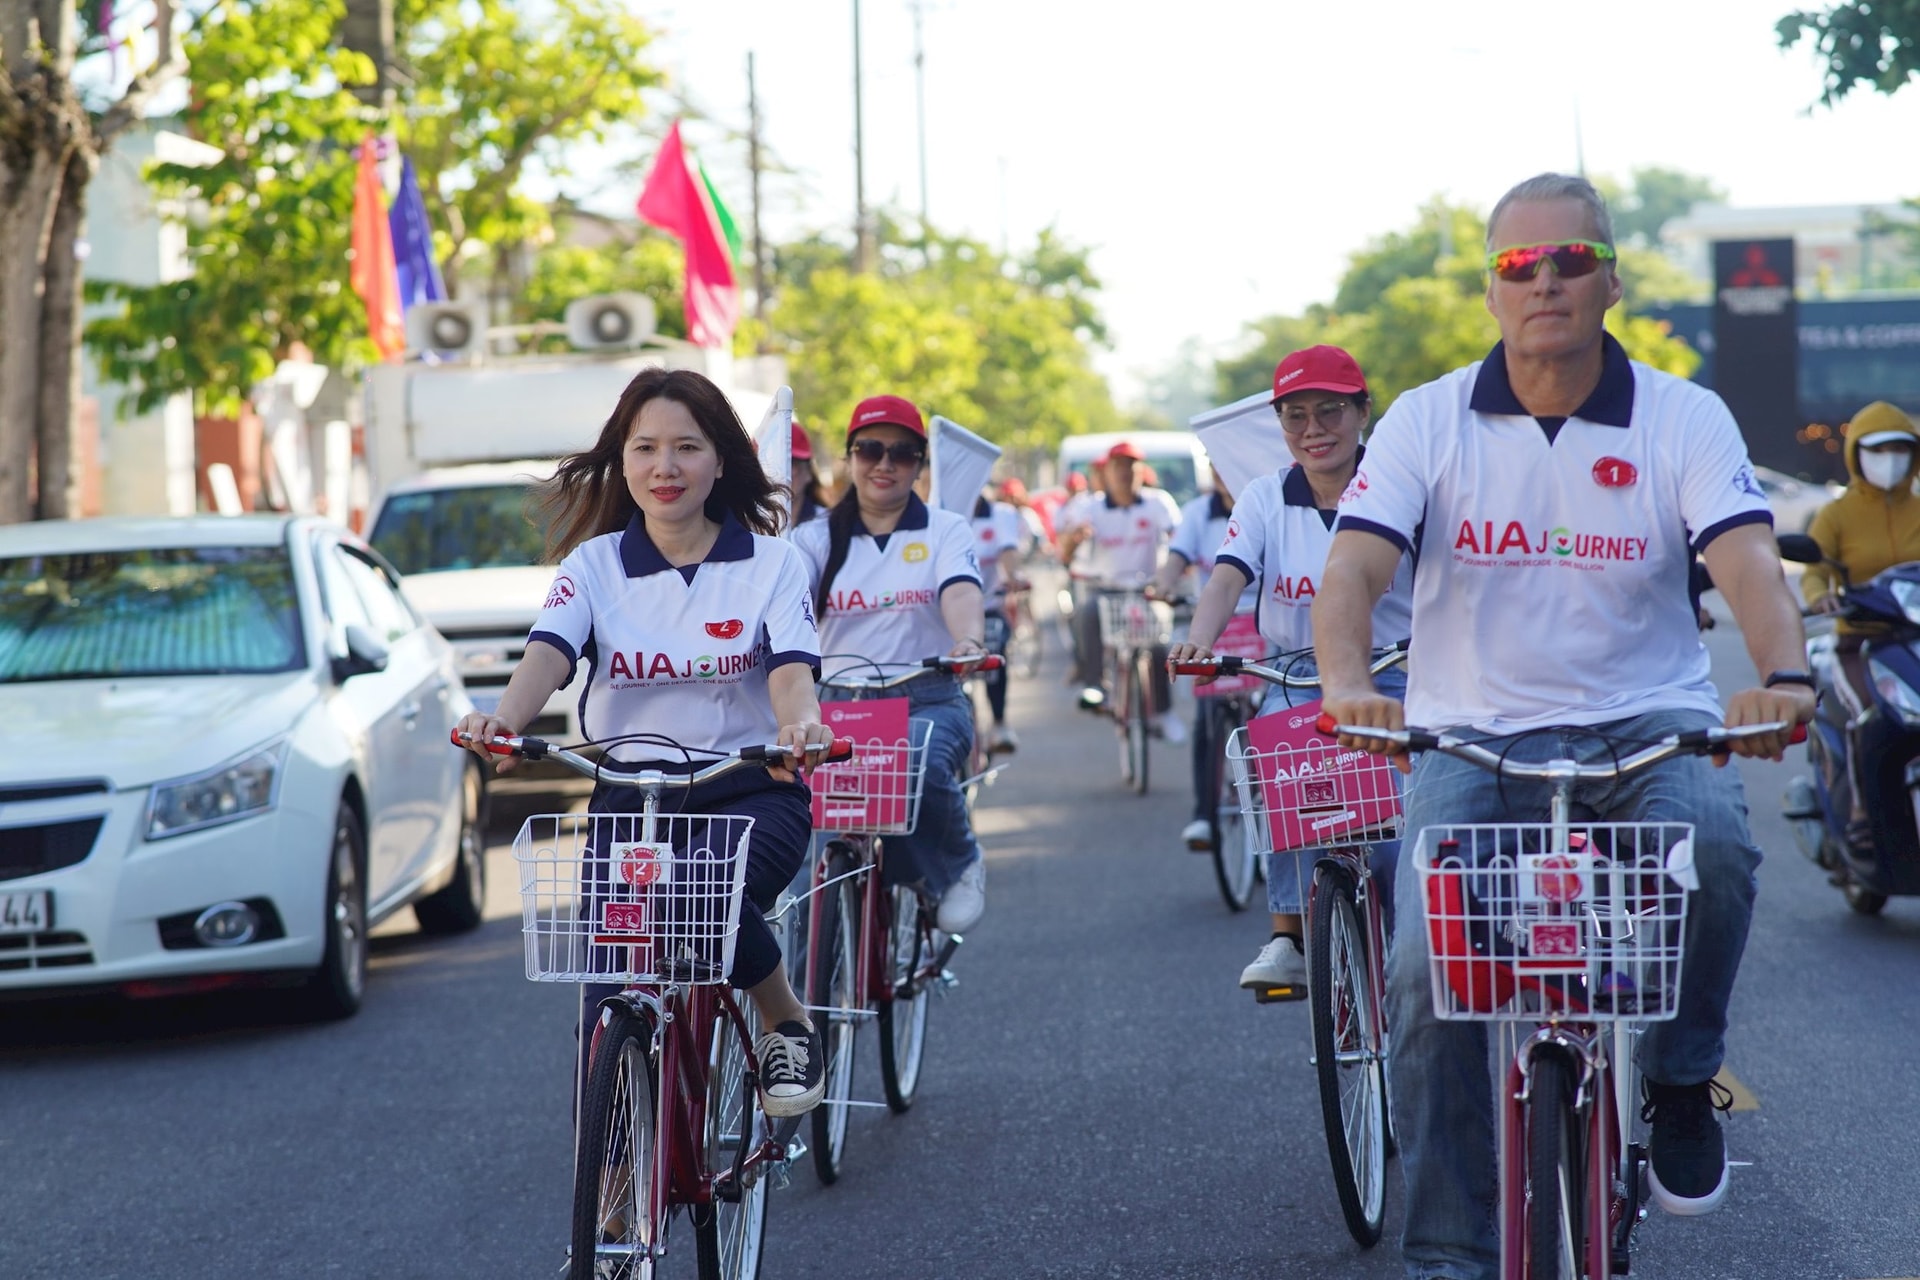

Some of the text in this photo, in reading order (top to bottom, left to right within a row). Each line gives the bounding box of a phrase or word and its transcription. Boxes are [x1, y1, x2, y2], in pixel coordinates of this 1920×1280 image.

[1609, 465, 1619, 482] 1
[1455, 519, 1649, 561] AIA JOURNEY
[1273, 573, 1316, 600] AIA
[610, 651, 678, 680] AIA
[620, 682, 651, 690] JOURNEY
[1274, 761, 1317, 786] AIA
[635, 860, 648, 876] 2
